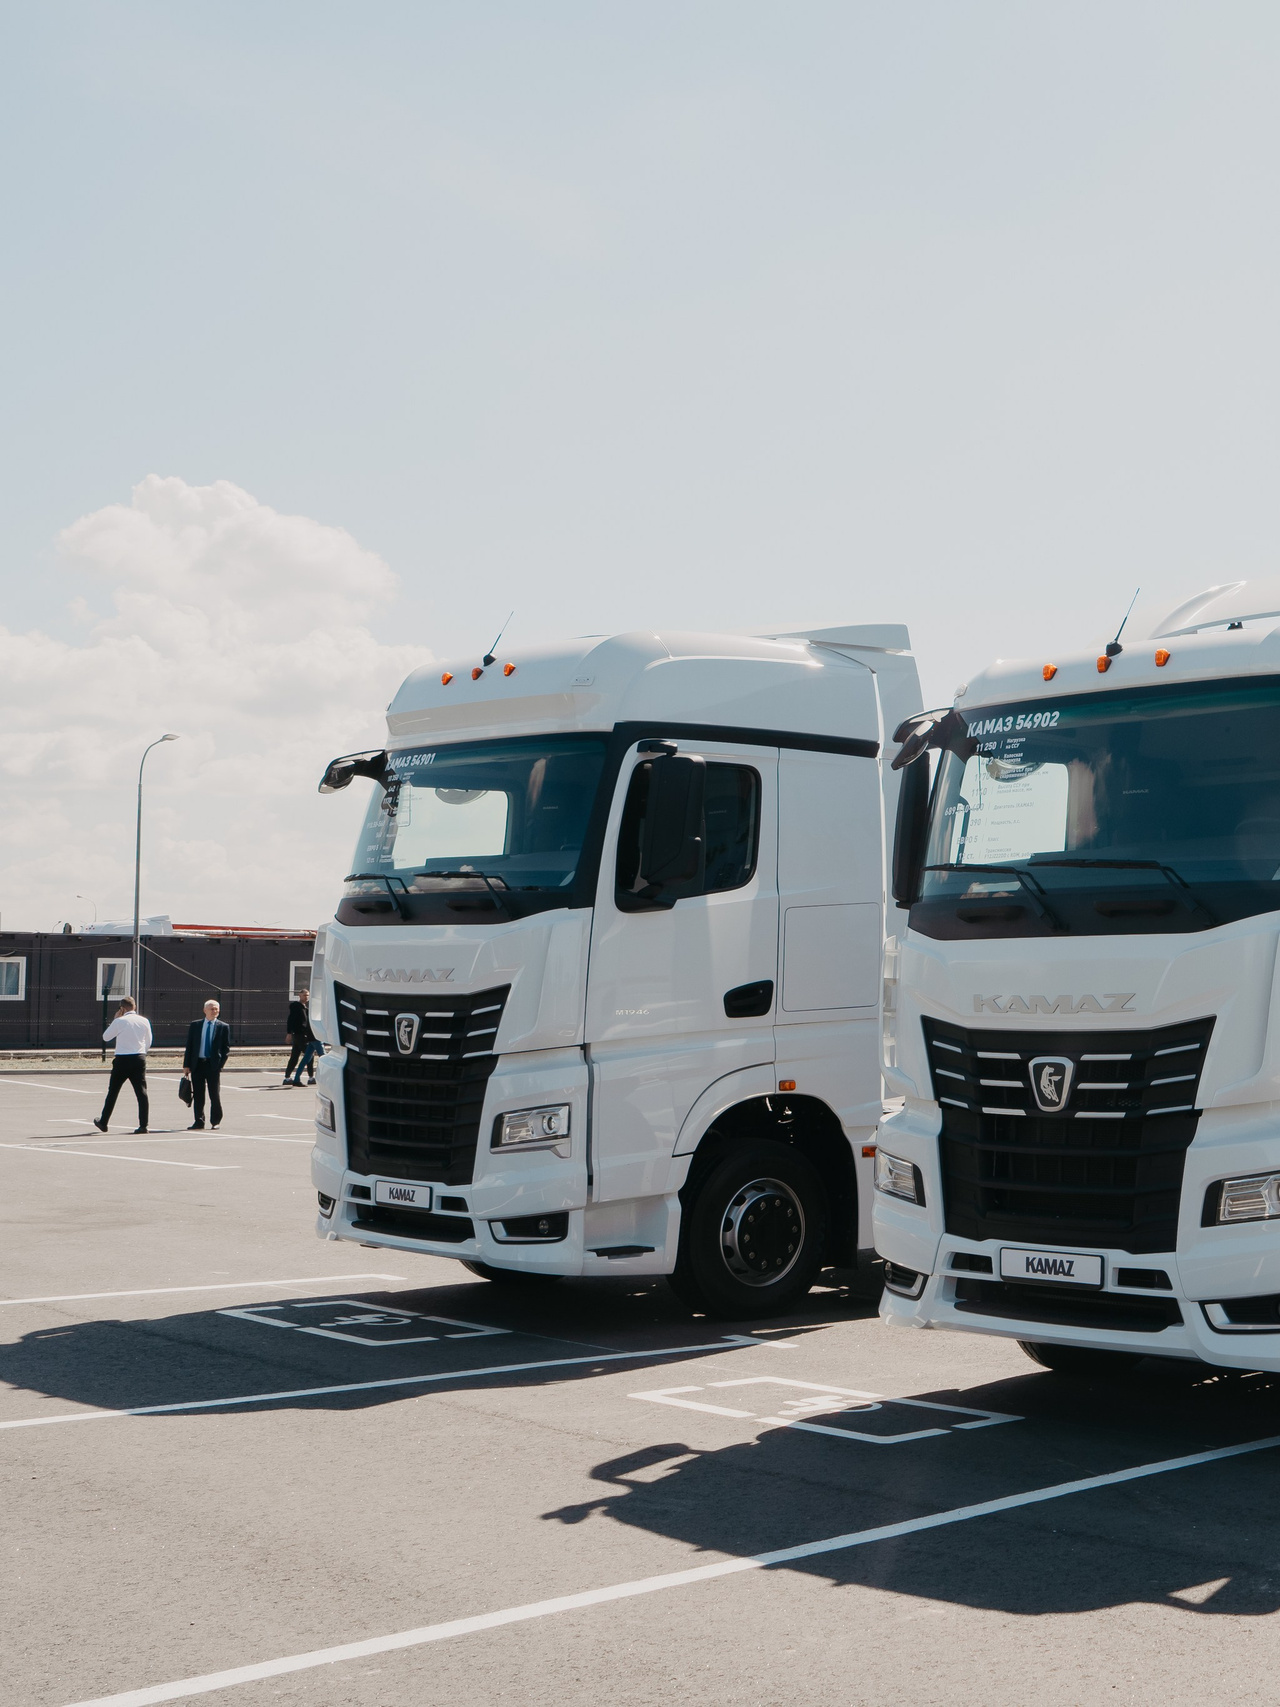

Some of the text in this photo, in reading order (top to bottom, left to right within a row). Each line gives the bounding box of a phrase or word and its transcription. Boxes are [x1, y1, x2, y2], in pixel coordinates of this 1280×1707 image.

[966, 710, 1060, 738] КАМАЗ 54902
[984, 741, 997, 751] 250
[410, 752, 436, 766] 54901
[365, 967, 456, 983] KAMAZ
[973, 993, 1137, 1015] KAMAZ
[388, 1187, 416, 1203] KAMAZ
[1025, 1256, 1075, 1278] KAMAZ
